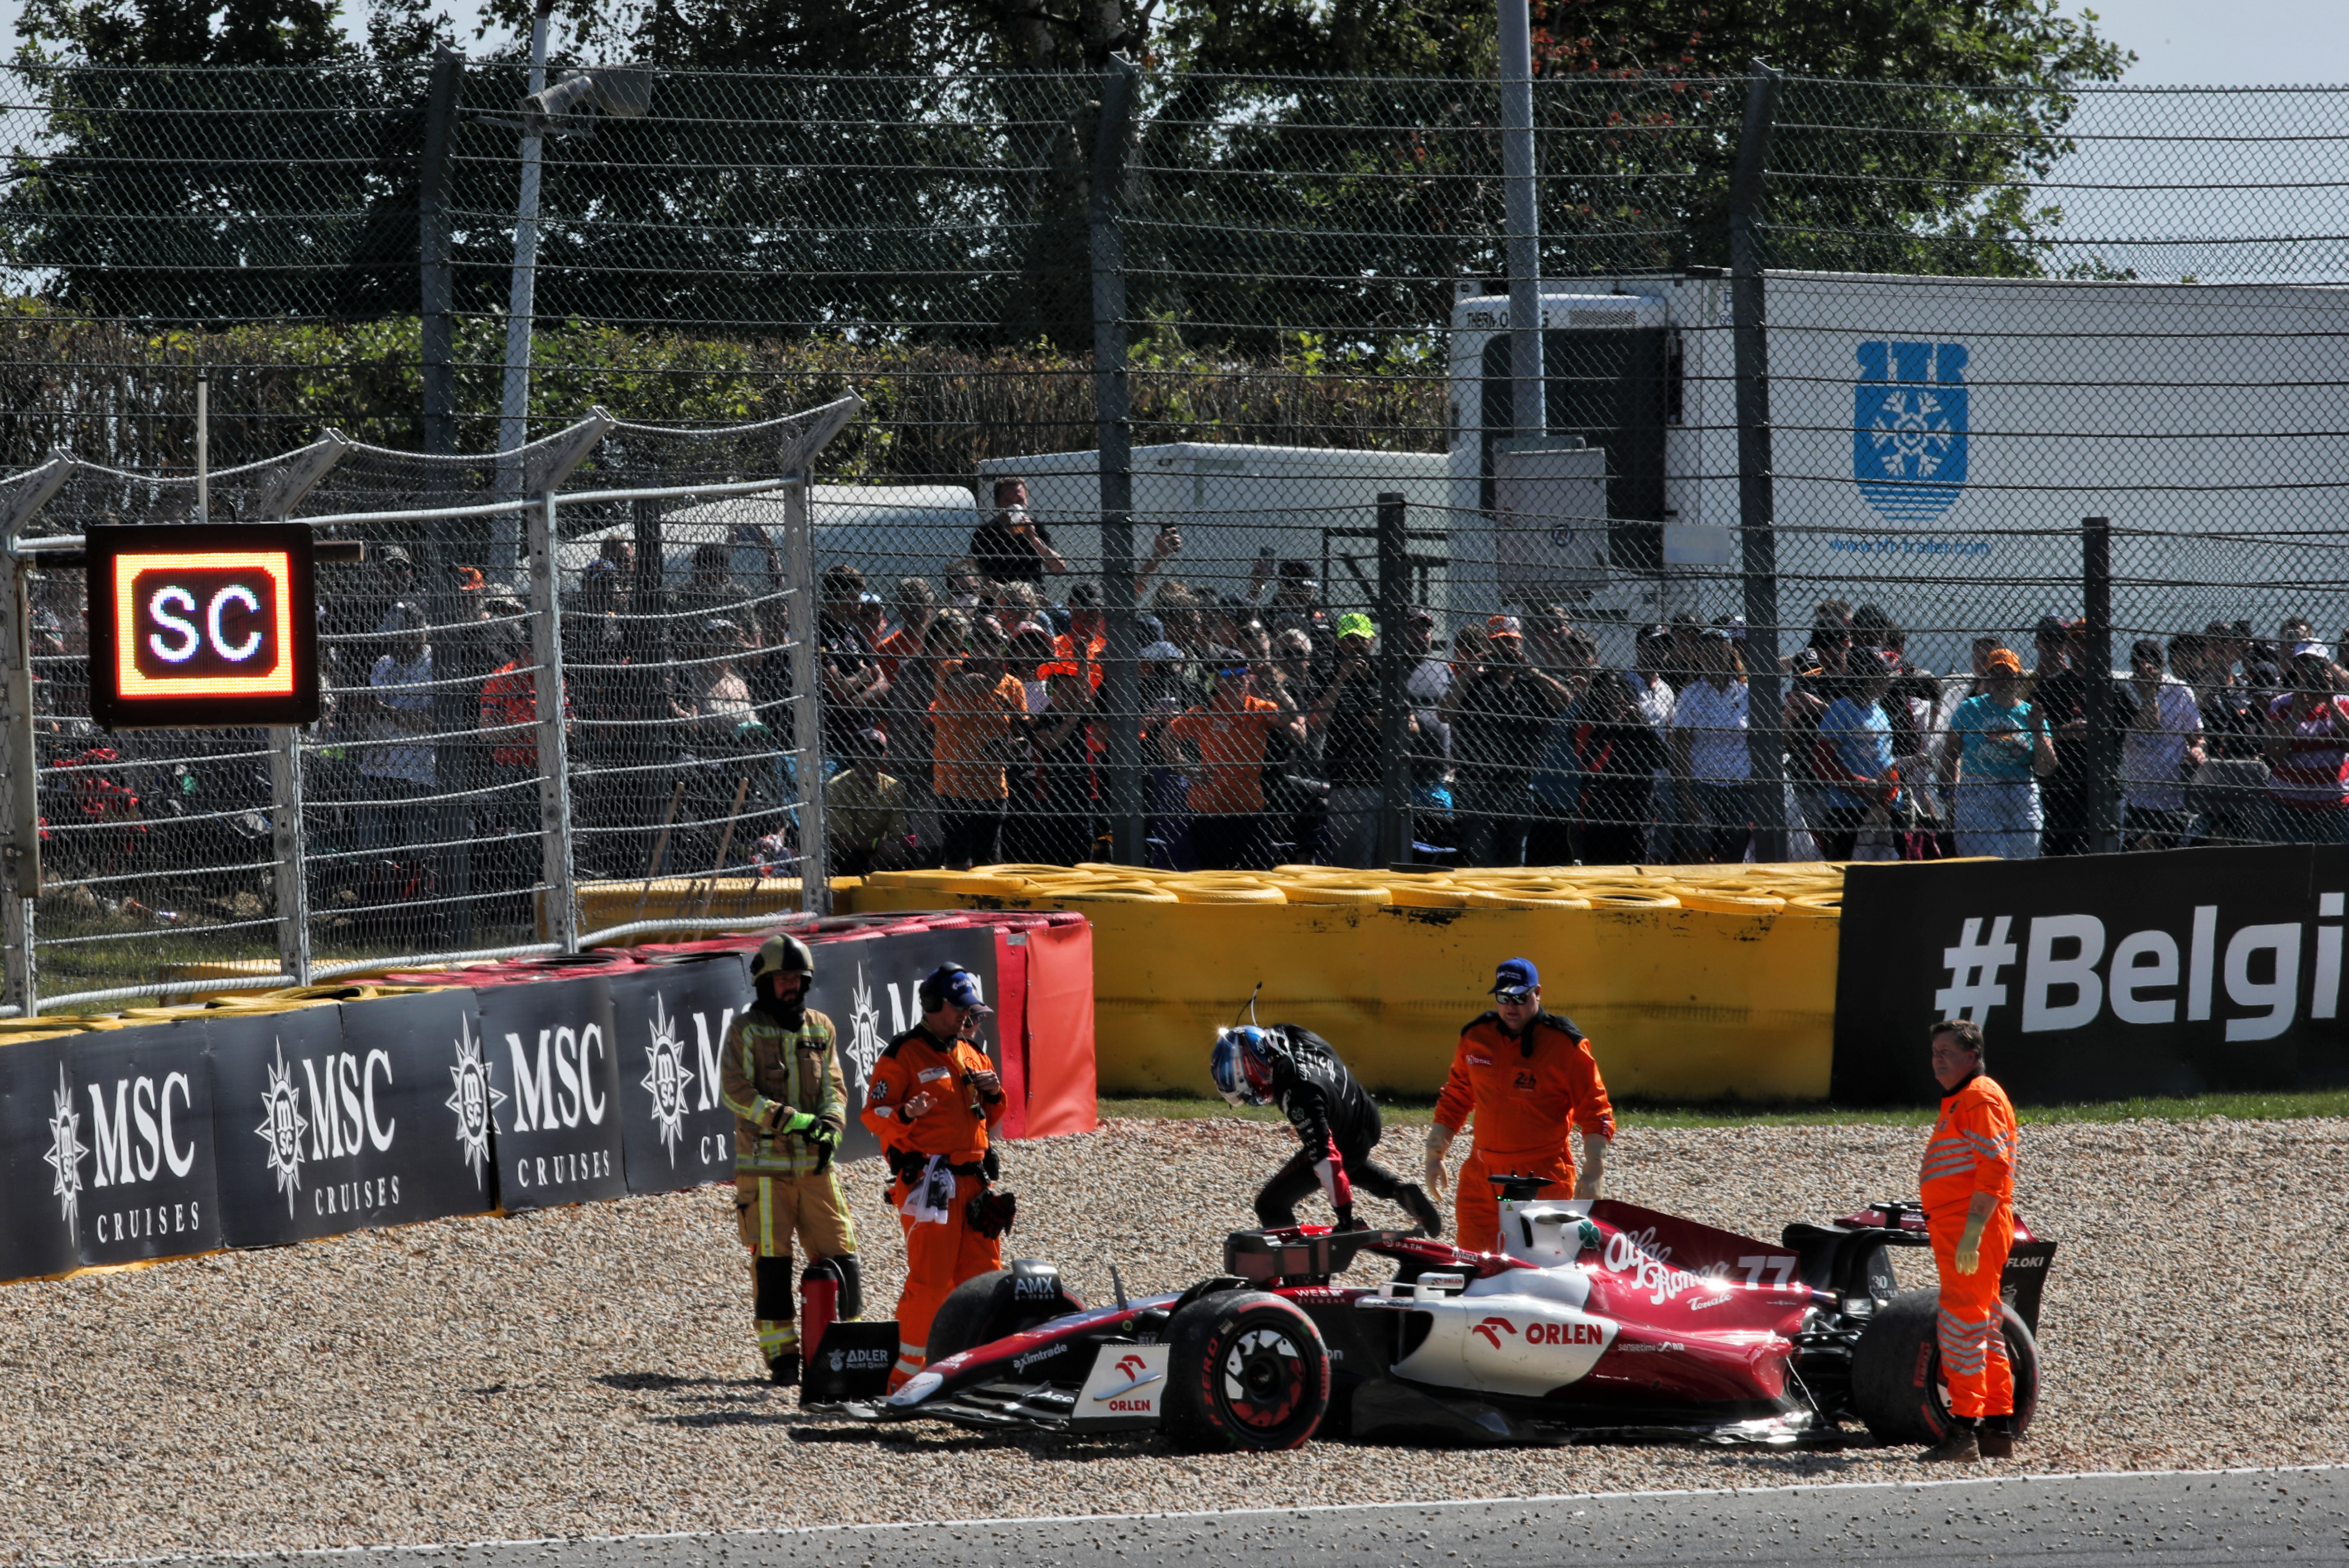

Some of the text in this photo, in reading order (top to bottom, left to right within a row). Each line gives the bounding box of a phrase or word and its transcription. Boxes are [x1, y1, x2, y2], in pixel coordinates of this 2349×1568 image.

[150, 584, 262, 663] SC
[1934, 892, 2345, 1043] #Belgi
[505, 1023, 606, 1133] MSC
[302, 1048, 395, 1161] MSC
[88, 1071, 195, 1188] MSC
[517, 1149, 610, 1188] CRUISES
[315, 1175, 400, 1216] CRUISES
[96, 1201, 199, 1244] CRUISES
[1737, 1256, 1797, 1291] 77
[2005, 1256, 2044, 1268] FLOKI
[1014, 1276, 1055, 1294] AMX
[1872, 1275, 1888, 1289] 30
[1686, 1292, 1733, 1311] Tonale
[1525, 1323, 1602, 1345] ORLEN
[1618, 1342, 1656, 1352] sensetime
[846, 1350, 888, 1362] ADLER
[1013, 1343, 1068, 1374] aximtrade
[1202, 1337, 1219, 1406] ZERO
[1109, 1399, 1151, 1412] ORLEN
